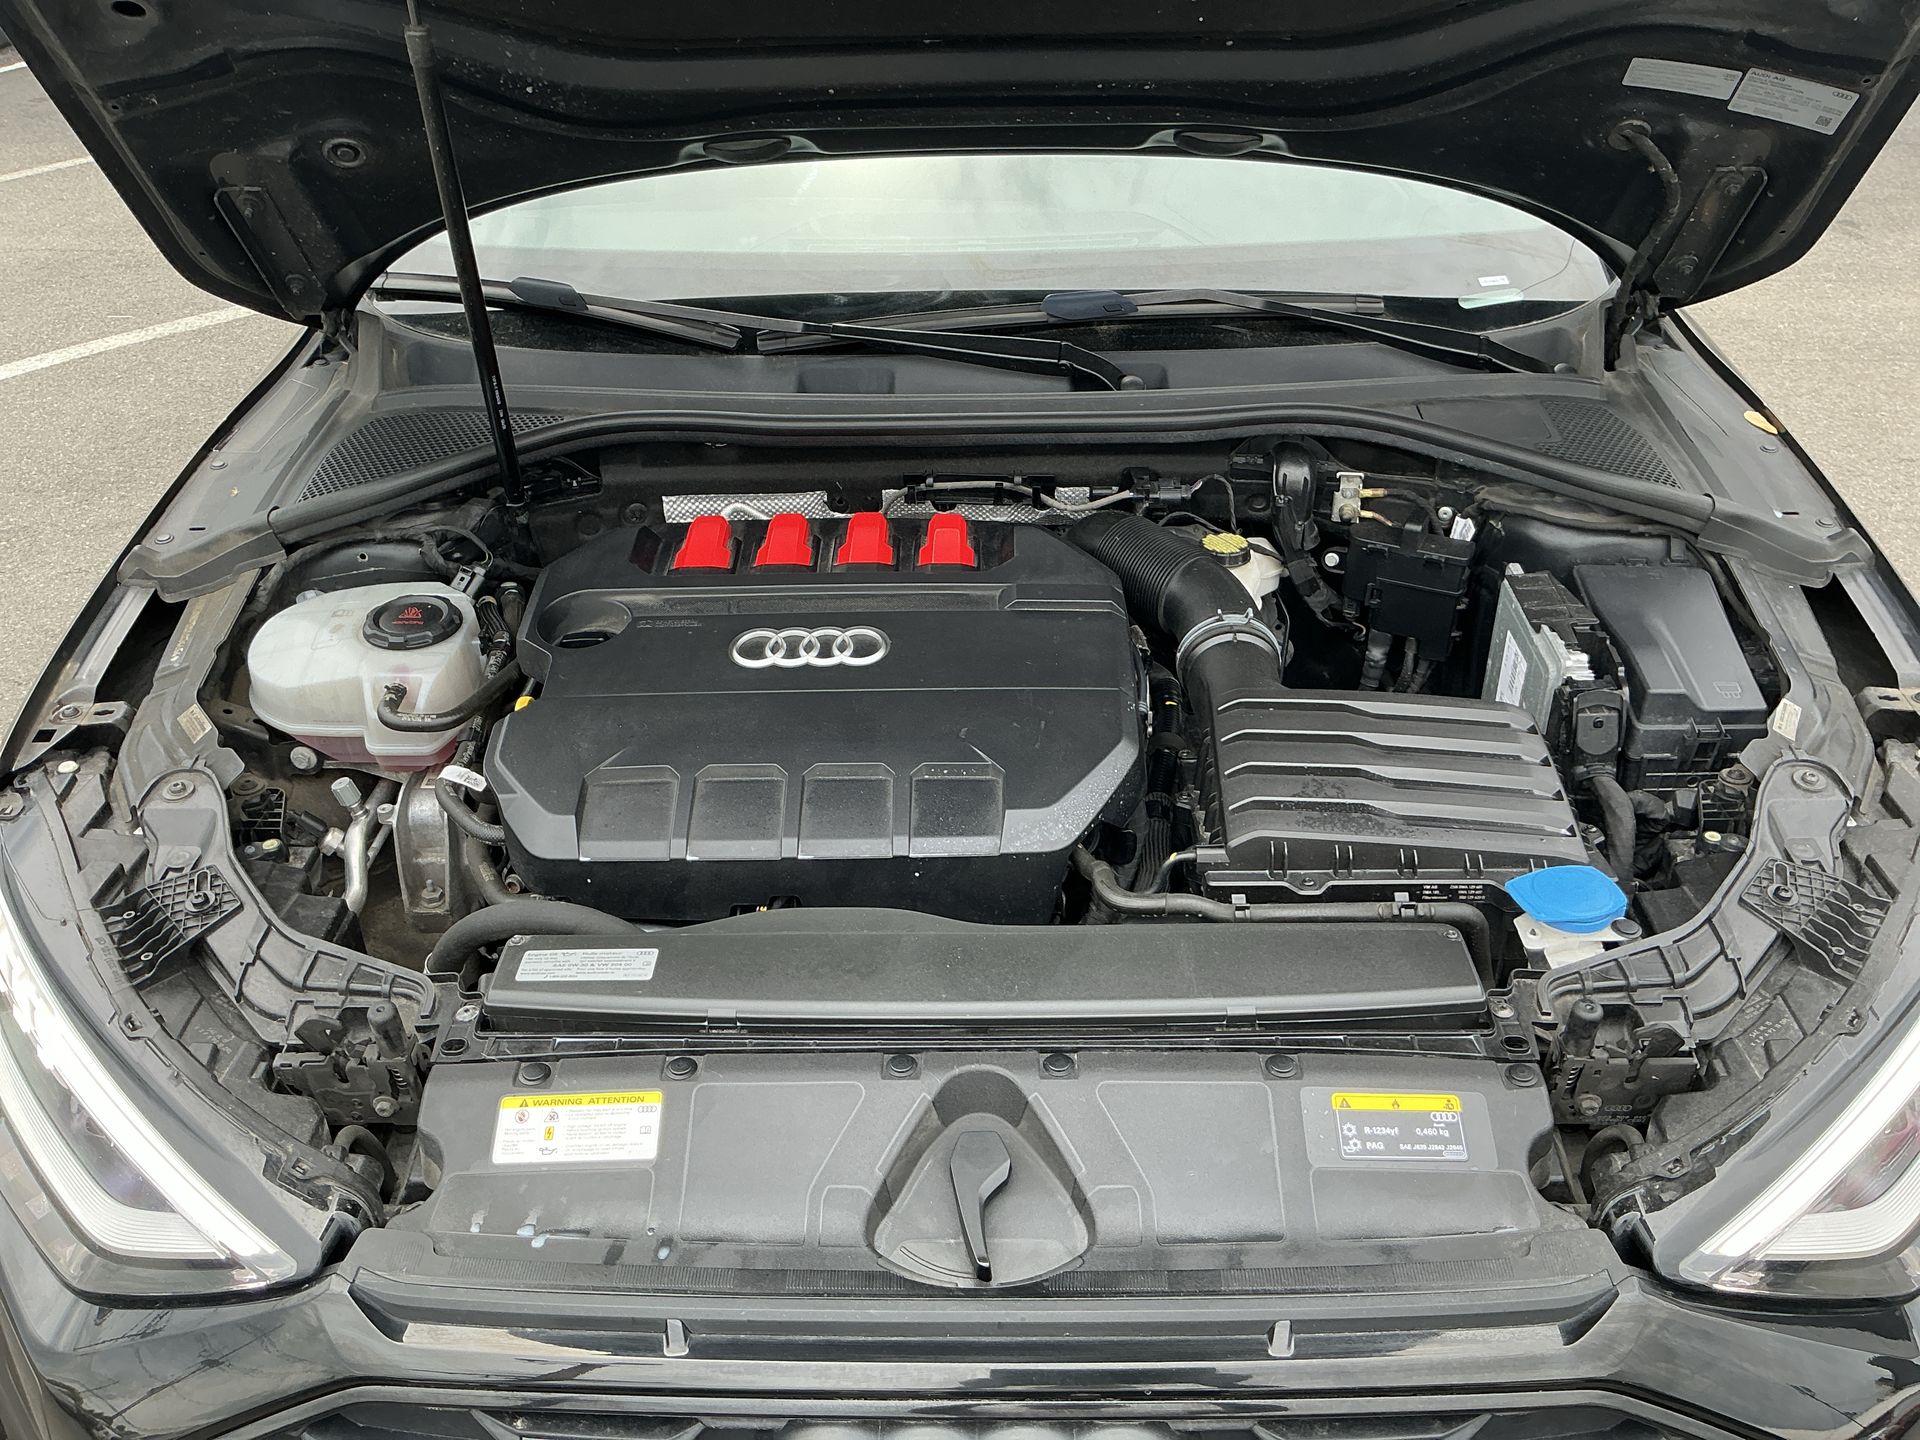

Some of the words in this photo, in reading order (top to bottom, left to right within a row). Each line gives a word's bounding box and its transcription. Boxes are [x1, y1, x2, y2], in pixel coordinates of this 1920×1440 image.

[532, 1097, 583, 1107] WARNING
[588, 1095, 645, 1105] ATTENTION
[1364, 1126, 1400, 1136] R-1234yf
[1439, 1128, 1449, 1137] kg
[1366, 1141, 1385, 1150] PAG
